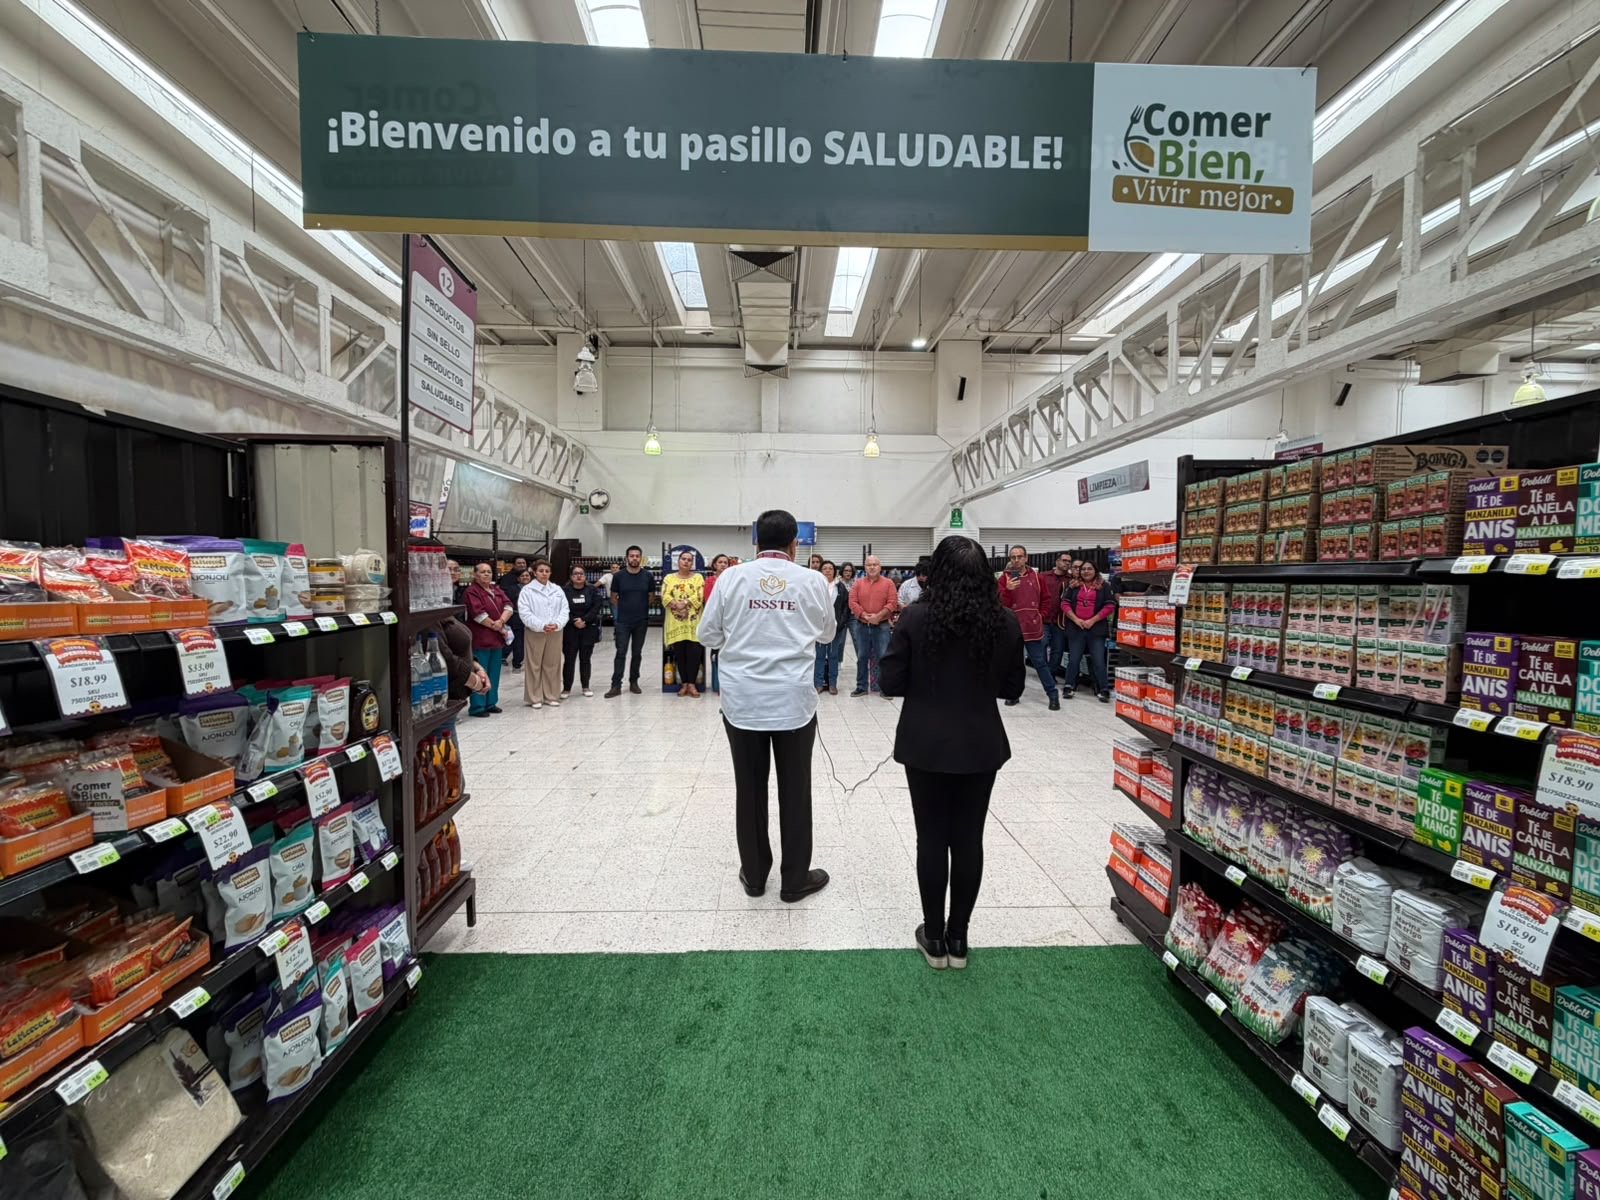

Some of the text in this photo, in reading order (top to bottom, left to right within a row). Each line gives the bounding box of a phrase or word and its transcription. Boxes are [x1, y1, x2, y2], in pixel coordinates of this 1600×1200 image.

[1143, 102, 1271, 138] Comer
[328, 110, 1063, 171] ¡Bienvenido a tu pasillo SALUDABLE!
[1158, 138, 1265, 183] Bien,
[1132, 177, 1273, 212] Vivir mejor
[440, 271, 454, 294] 12
[424, 294, 465, 334] PRODUCTOS
[426, 327, 460, 359] SIN SELLO
[423, 353, 464, 388] PRODUCTOS
[420, 379, 464, 412] SALUDABLES
[1089, 477, 1117, 492] LIMPIEZA
[1530, 489, 1556, 503] TÉ DE
[1476, 494, 1502, 508] TÉ DE
[1519, 501, 1575, 516] CANELA
[1466, 508, 1515, 519] MANZANILLA
[1530, 515, 1559, 526] A LA
[1516, 526, 1572, 539] MANZANA
[748, 599, 796, 611] ISSSTE
[187, 661, 214, 673] $33.00
[1473, 649, 1497, 665] TÉ DE
[1529, 655, 1554, 671] TÉ DE
[70, 674, 107, 688] $18.99
[1464, 664, 1508, 677] MANZANILLA
[1519, 669, 1573, 686] CANELA
[1516, 691, 1570, 710] MANZANA
[1530, 682, 1557, 695] A LA
[76, 782, 112, 791] Comer
[1548, 771, 1594, 792] $18.90
[81, 791, 112, 801] Bien,
[1418, 797, 1457, 827] VERDE
[1473, 801, 1499, 823] TÉ DE
[1422, 816, 1457, 840] MANGO
[1464, 813, 1511, 838] MANZANILLA
[1528, 819, 1553, 841] TÉ DE
[213, 829, 238, 848] $22.90
[1516, 831, 1571, 860] CANELA
[1514, 852, 1568, 880] MANZANA
[1527, 846, 1555, 866] A LA
[1497, 919, 1537, 944] $18.90
[1451, 949, 1475, 974] TÉ DE
[1444, 960, 1486, 992] MANZANILLA
[1506, 981, 1531, 1007] TÉ DE
[1496, 991, 1550, 1030] CANELA
[1507, 1008, 1534, 1032] A LA
[1495, 1010, 1549, 1055] MANZANA
[1566, 1012, 1600, 1046] TÉ DE
[1413, 1053, 1441, 1081] TÉ DE
[1404, 1061, 1455, 1099] MANZANILLA
[1464, 1087, 1475, 1104] TÉ
[1456, 1095, 1499, 1141] CANELA
[1465, 1115, 1488, 1142] A LA
[1411, 1126, 1437, 1156] TÉ DE
[1456, 1115, 1500, 1164] MANZANA
[1517, 1131, 1548, 1165] TÉ DE
[1459, 1167, 1471, 1186] TÉ
[1506, 1139, 1565, 1191] DOBLE
[1577, 1173, 1594, 1199] TÉ
